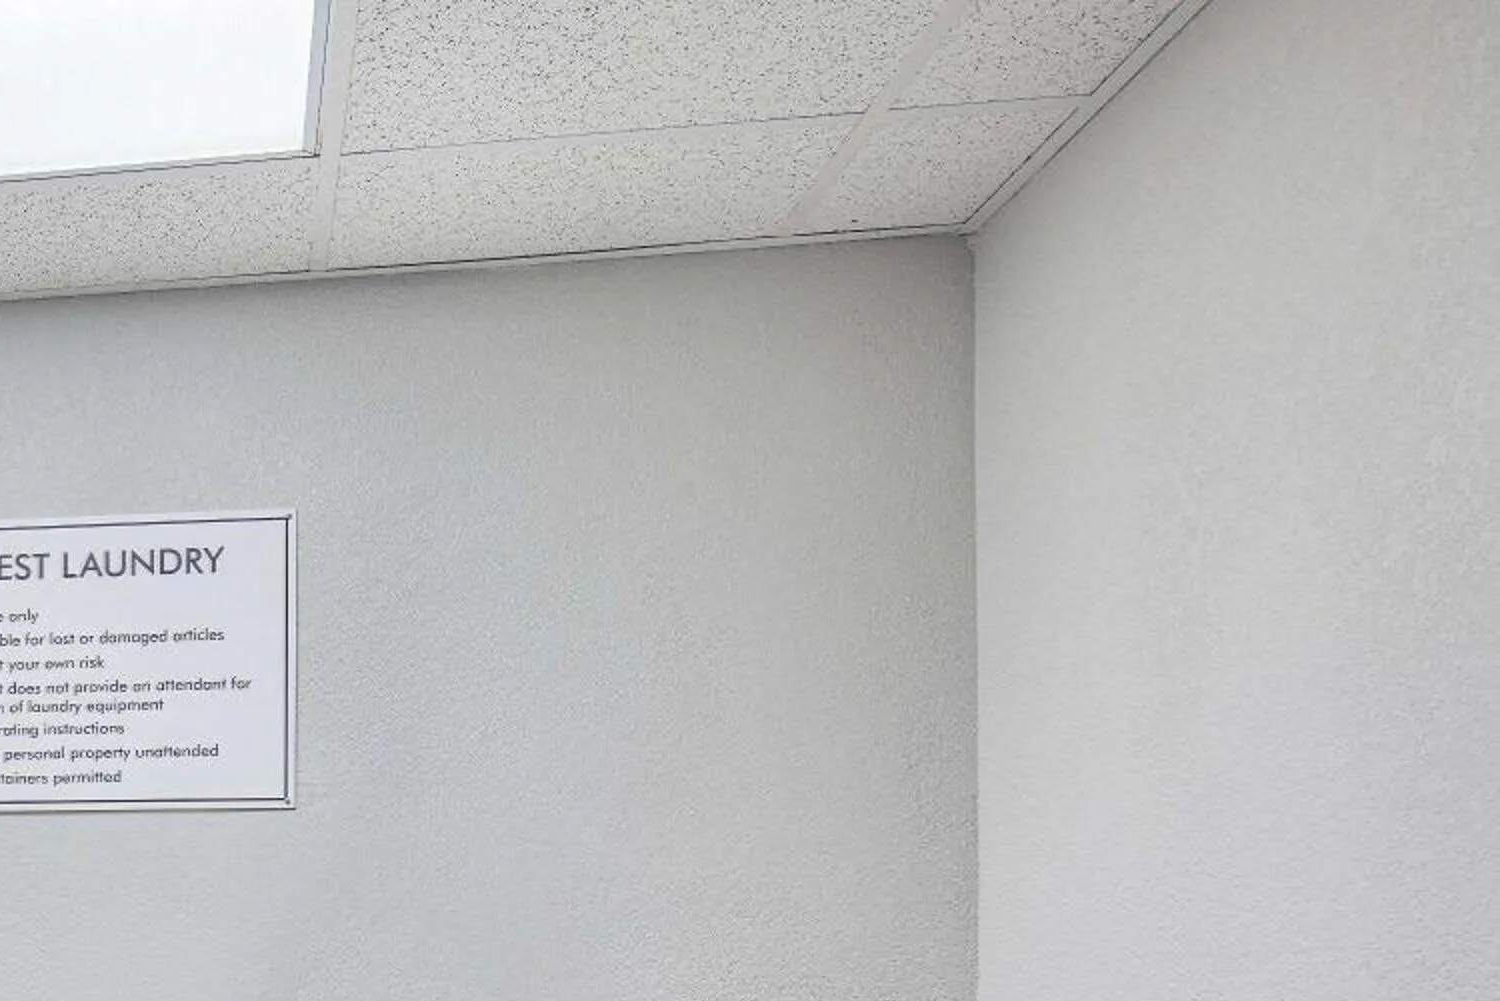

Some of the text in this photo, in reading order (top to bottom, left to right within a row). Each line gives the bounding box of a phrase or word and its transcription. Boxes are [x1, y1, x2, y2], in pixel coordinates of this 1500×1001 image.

[62, 546, 224, 578] LAUNDRY
[9, 609, 39, 625] only
[25, 633, 44, 646] for
[49, 632, 75, 645] lost
[79, 634, 94, 645] or
[99, 630, 167, 646] damaged
[173, 629, 225, 641] articles
[8, 660, 39, 672] your
[44, 658, 75, 669] own
[79, 657, 104, 669] risk
[8, 682, 41, 695] does
[45, 682, 68, 694] not
[73, 680, 128, 696] provide
[133, 681, 151, 692] an
[156, 678, 227, 692] attendant
[230, 676, 251, 690] for
[9, 701, 24, 714] of
[27, 700, 81, 717] laundry
[87, 699, 164, 715] equipment
[43, 722, 124, 735] instructions
[3, 746, 65, 763] personal
[71, 745, 130, 762] property
[135, 744, 219, 758] unattended
[53, 770, 122, 786] permitted
